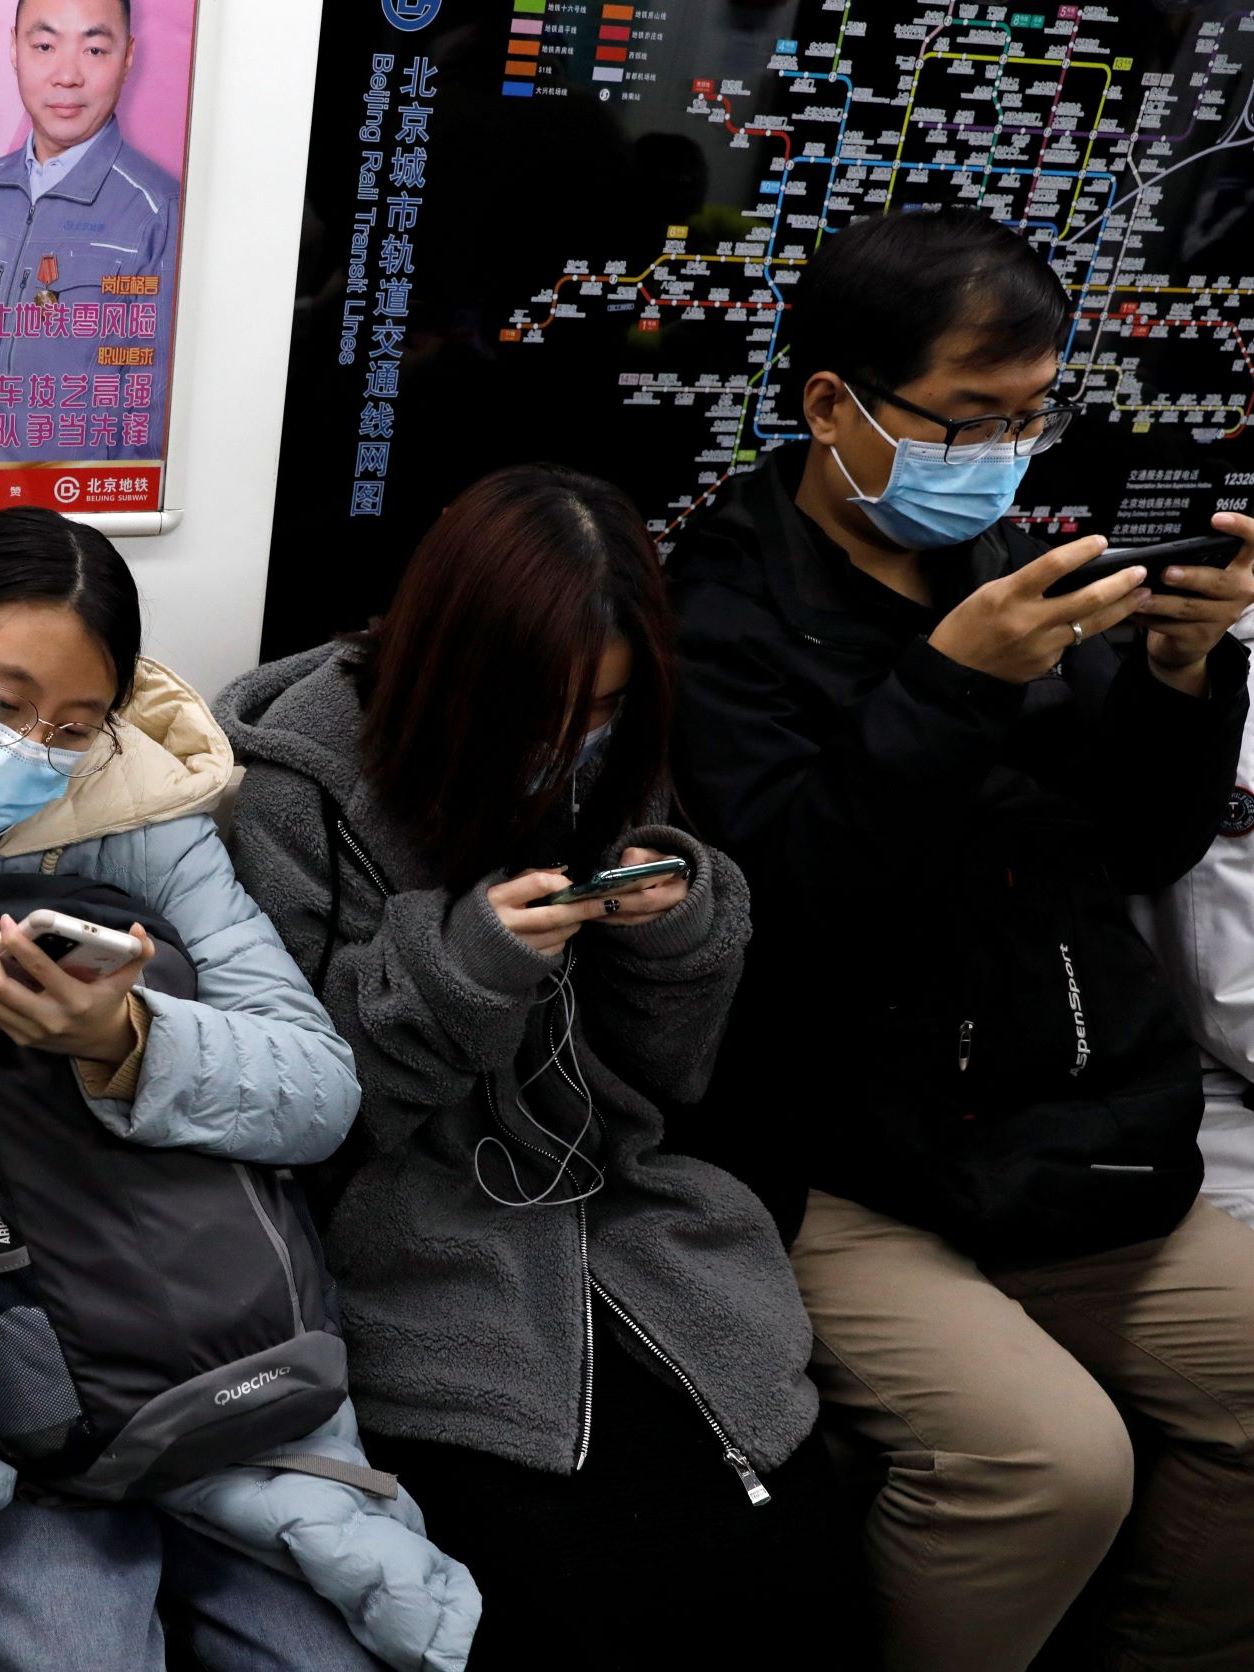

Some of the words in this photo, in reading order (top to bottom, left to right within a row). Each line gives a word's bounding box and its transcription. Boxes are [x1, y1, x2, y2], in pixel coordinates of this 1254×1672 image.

[359, 53, 395, 143] Beijing
[357, 150, 384, 201] Rail
[346, 207, 376, 293] Transit
[101, 275, 160, 296] 岗位格言
[349, 56, 439, 517] 北京城市轨道交通线网图
[338, 299, 366, 366] Lines
[97, 346, 155, 366] 职业追求
[85, 494, 116, 502] BEIJING
[117, 494, 149, 502] SUBWAY
[86, 476, 149, 493] 北京地铁
[1224, 473, 1254, 486] 12328
[1215, 498, 1249, 511] 96165
[1059, 943, 1091, 1077] AspenSport
[214, 1366, 291, 1406] Quechua
